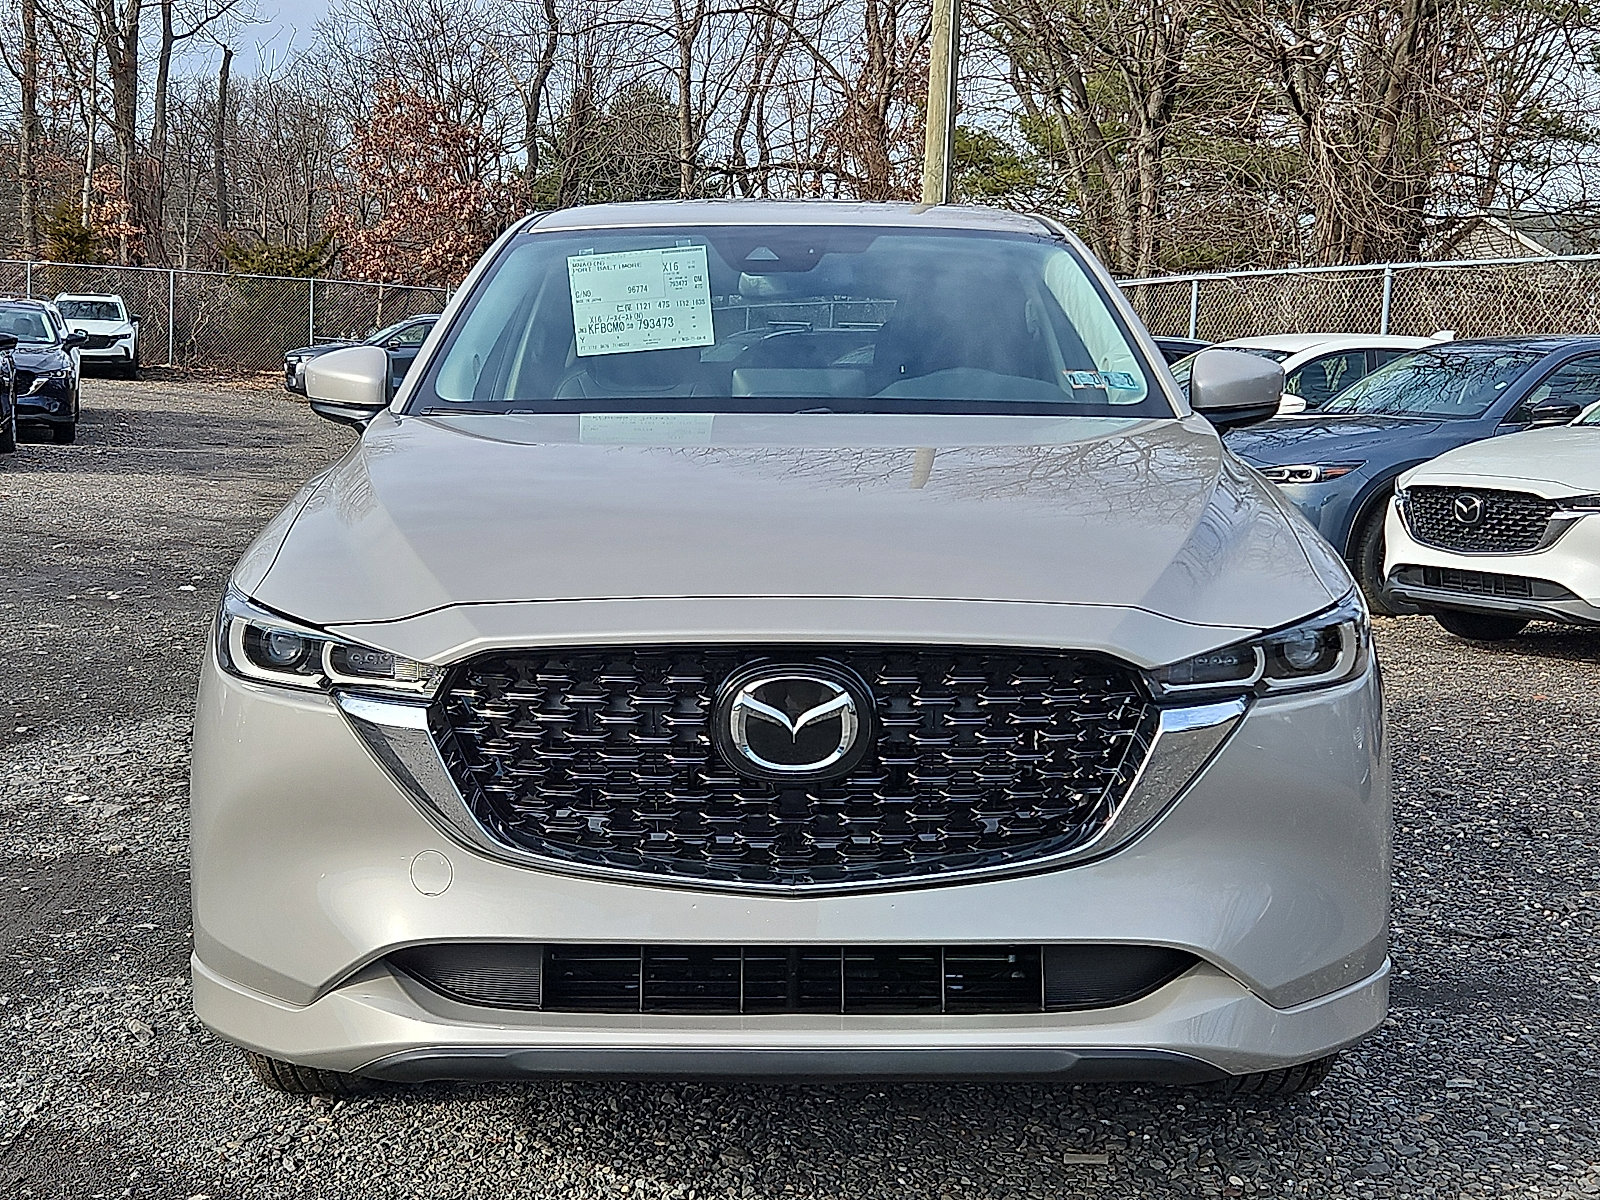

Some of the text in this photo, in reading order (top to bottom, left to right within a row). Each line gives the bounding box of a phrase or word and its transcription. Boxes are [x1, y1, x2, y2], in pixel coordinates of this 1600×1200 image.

[597, 263, 641, 271] BALTIMORE
[662, 262, 679, 272] X16
[627, 285, 648, 293] 96774
[636, 302, 651, 310] 1121
[637, 317, 674, 330] 793473
